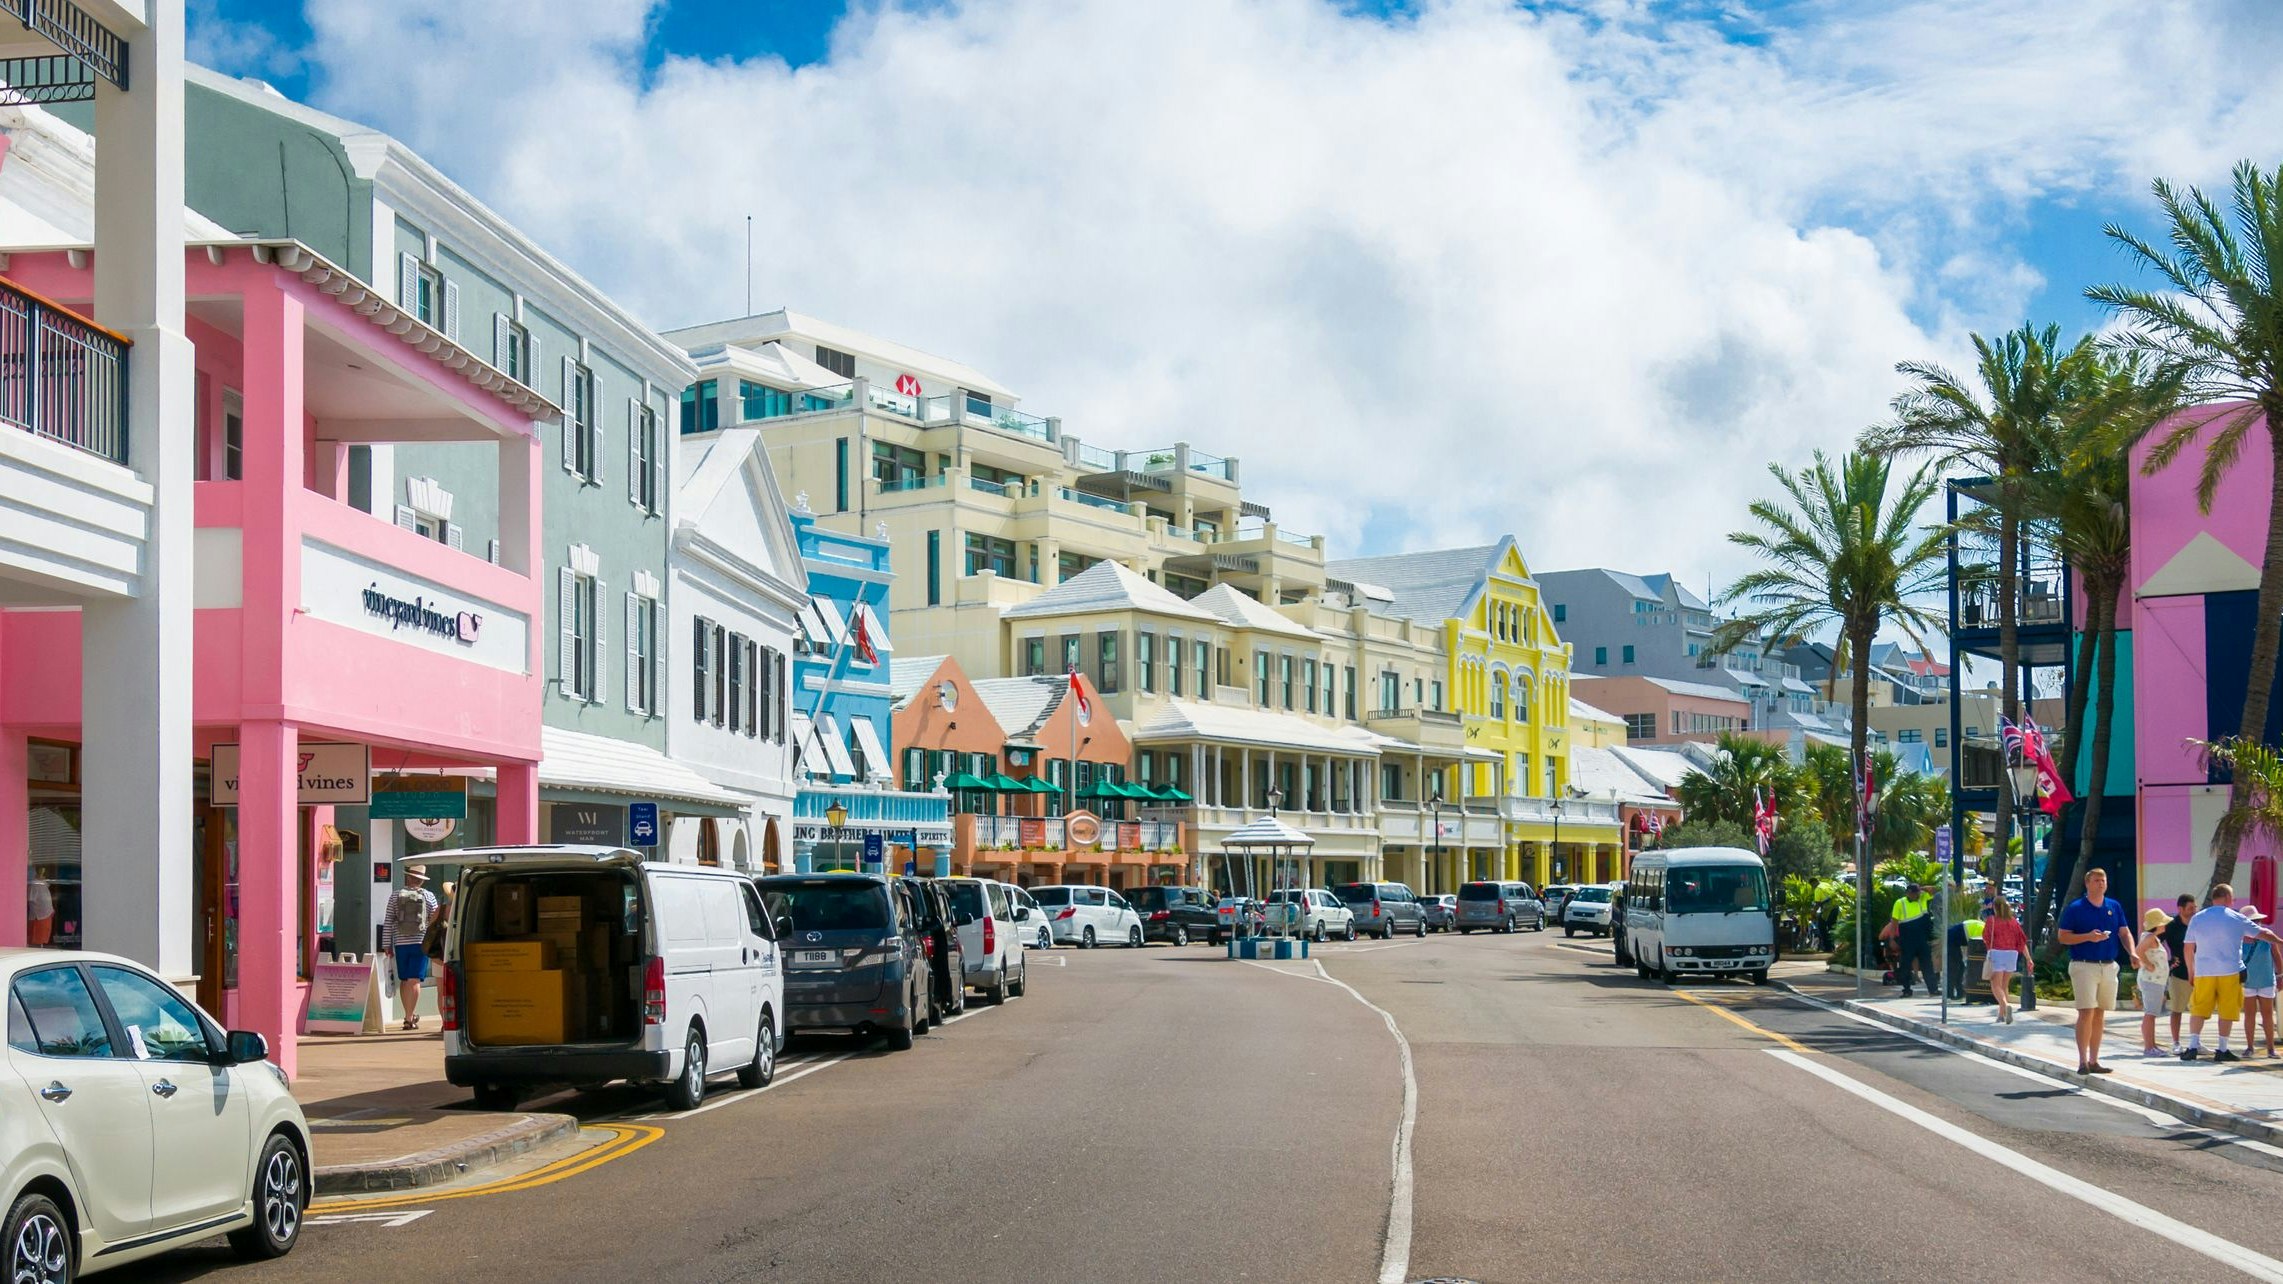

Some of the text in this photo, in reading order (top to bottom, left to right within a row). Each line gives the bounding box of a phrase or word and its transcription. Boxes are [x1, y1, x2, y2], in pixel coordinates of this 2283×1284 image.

[363, 582, 455, 638] vineyard vines
[308, 775, 354, 790] vines
[920, 832, 948, 841] SPIRITS
[804, 952, 827, 961] T1188
